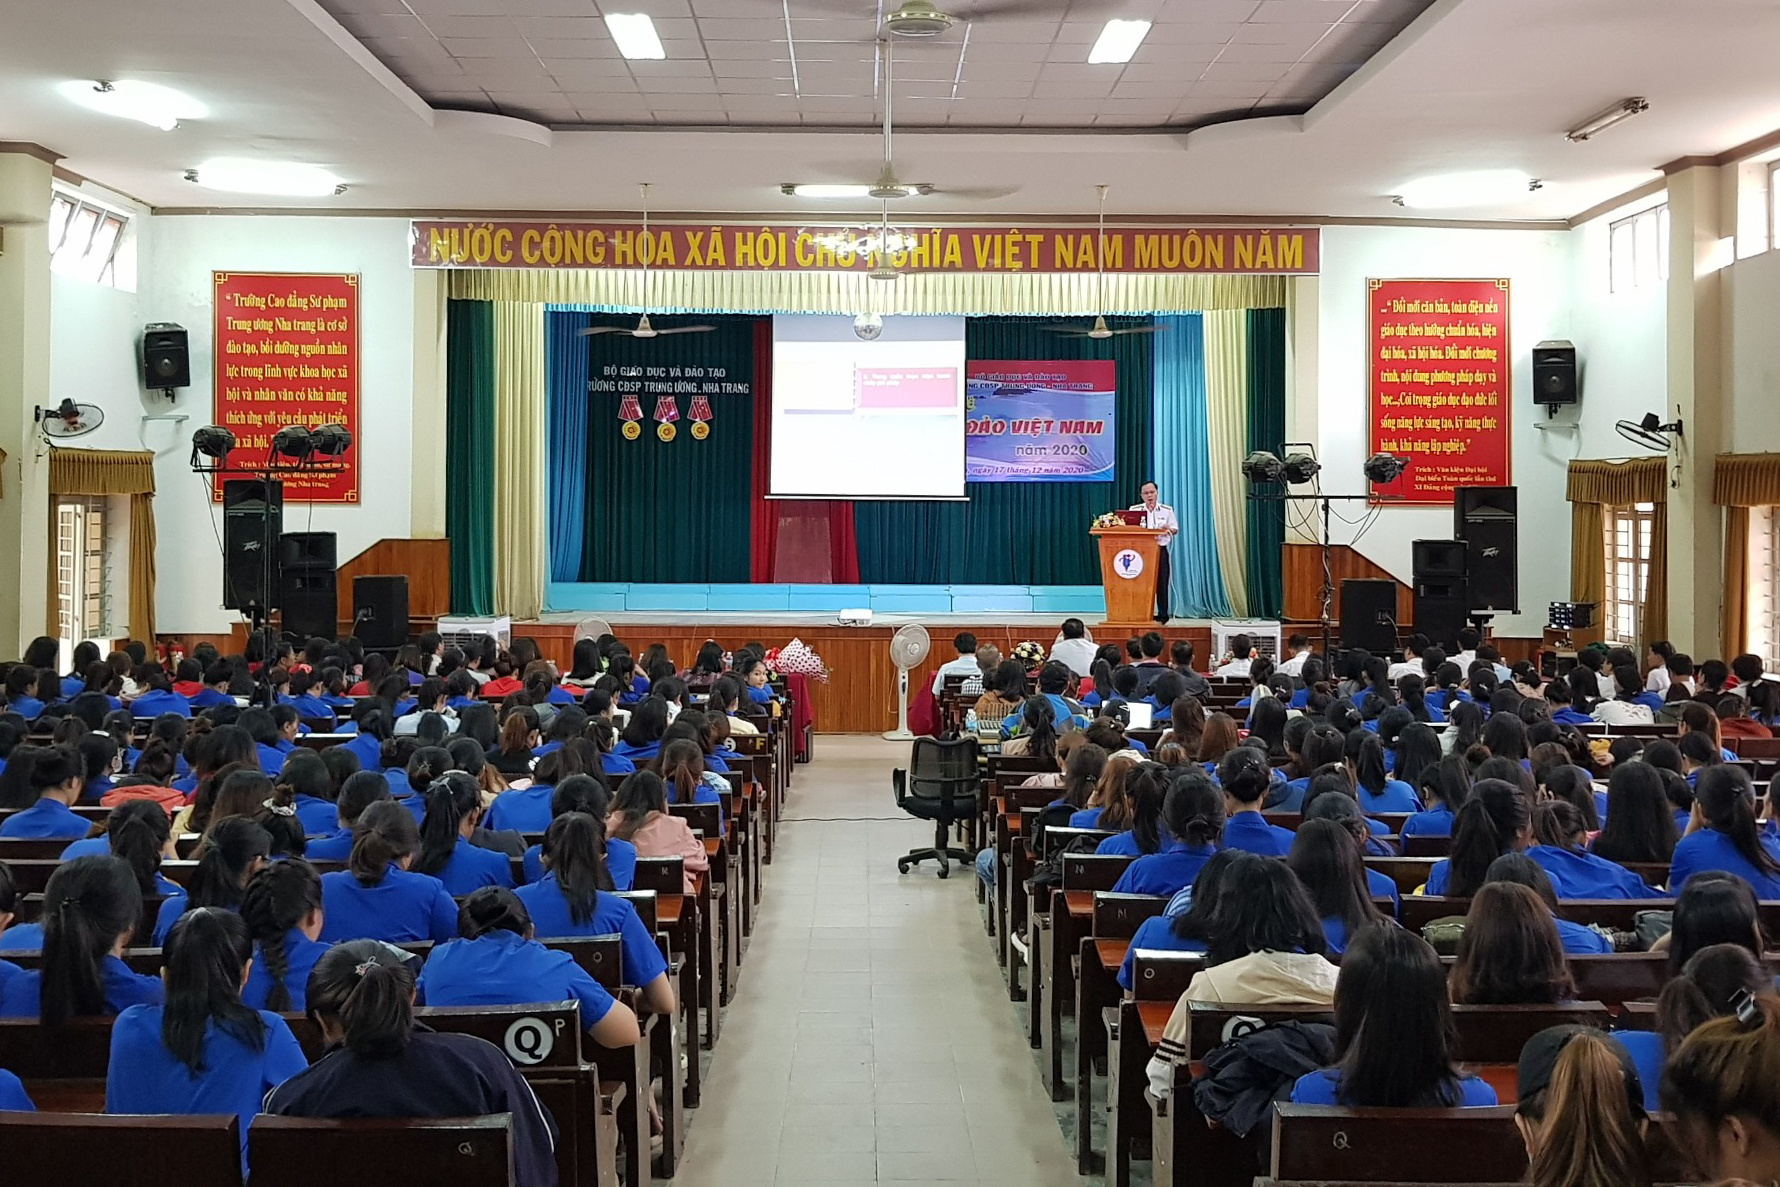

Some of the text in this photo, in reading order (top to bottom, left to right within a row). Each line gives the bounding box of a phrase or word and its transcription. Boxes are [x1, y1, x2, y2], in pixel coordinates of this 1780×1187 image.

[429, 223, 513, 264] NƯỚC
[521, 223, 606, 270] CỘNG
[684, 226, 726, 267] XÃ
[735, 226, 787, 271] HỘI
[971, 228, 1044, 272] VIỆT
[1054, 234, 1123, 270] NAM
[1134, 227, 1225, 270] MUÔN
[1234, 229, 1304, 270] NĂM
[267, 293, 285, 307] Cao
[323, 294, 347, 311] phạm
[226, 316, 252, 334] Trung
[274, 317, 292, 331] Nha
[293, 319, 316, 335] trang
[317, 317, 325, 331] là
[1408, 323, 1423, 336] theo
[327, 341, 348, 354] nhân
[241, 364, 263, 381] trong
[299, 364, 320, 378] khoa
[321, 364, 336, 380] học
[337, 364, 348, 378] xã
[603, 364, 726, 380] BỘ GIÁO DỤC VÀ ĐÀO TẠO
[587, 377, 749, 394] RƯỜNG CĐSP TRUNG ƯƠNG NHA TRANG
[226, 387, 240, 403] hội
[242, 388, 252, 401] và
[254, 388, 276, 401] nhân
[295, 388, 306, 401] có
[307, 386, 324, 401] khả
[325, 388, 347, 405] năng
[277, 412, 292, 427] yêu
[1011, 418, 1054, 437] VIỆT
[1059, 420, 1103, 434] NAM
[242, 434, 252, 448] xã
[1016, 444, 1088, 456] năm 2020
[755, 737, 767, 750] F
[555, 1018, 566, 1037] P
[514, 1025, 543, 1060] Q
[1333, 1131, 1351, 1150] Q
